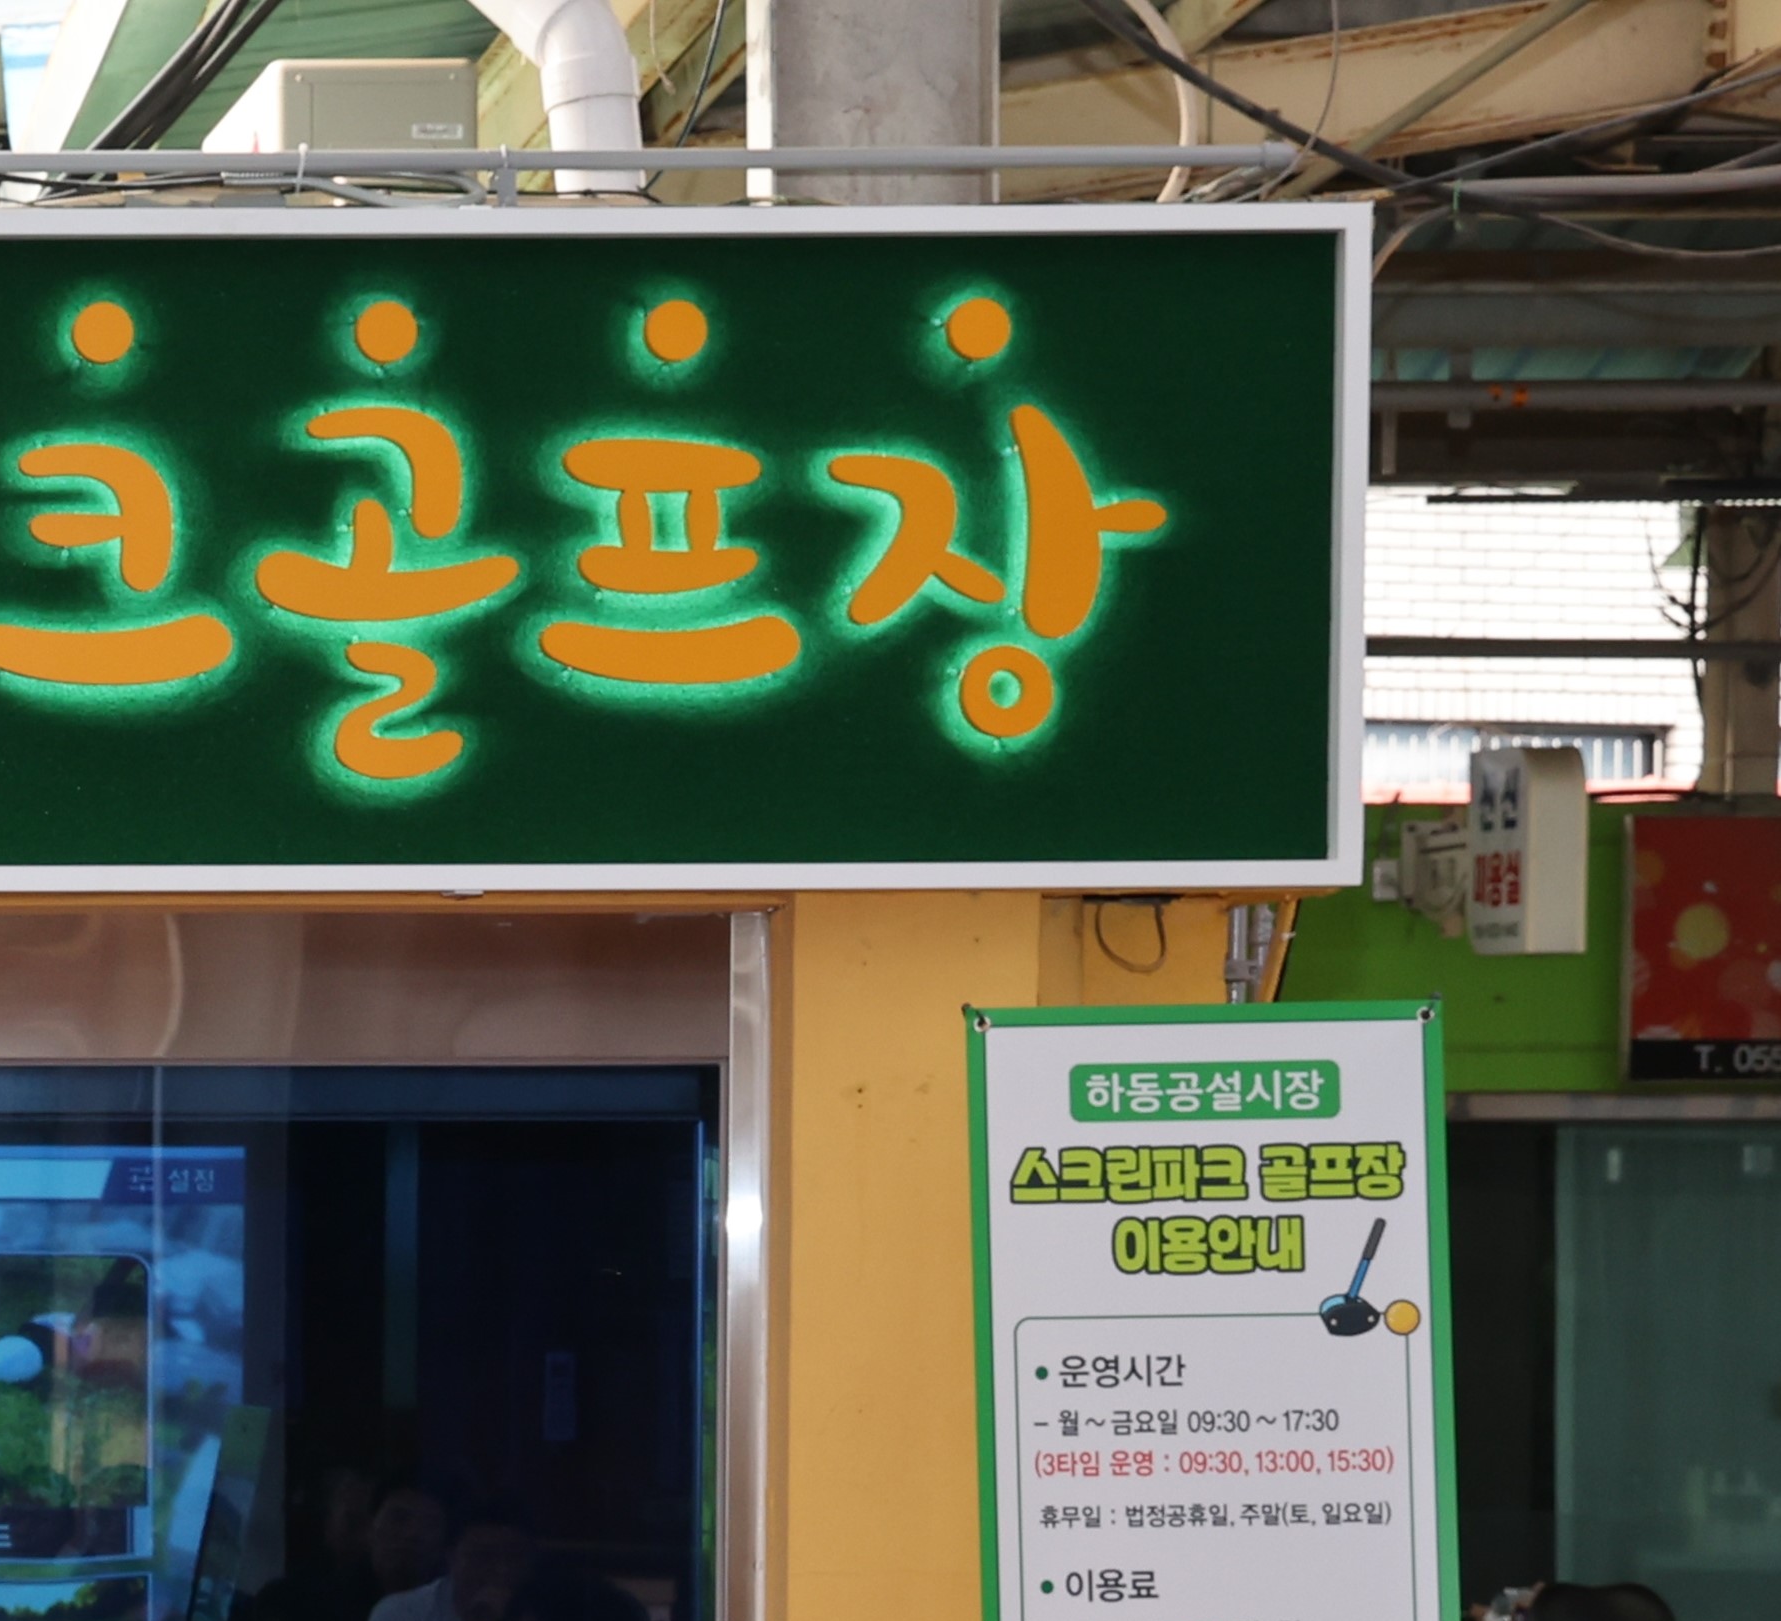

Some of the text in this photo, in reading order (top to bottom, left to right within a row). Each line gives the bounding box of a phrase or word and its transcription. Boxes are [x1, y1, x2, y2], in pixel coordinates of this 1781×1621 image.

[1086, 1069, 1326, 1114] 하동공설시장
[1010, 1142, 1407, 1204] 스크린파크 골프장
[1113, 1215, 1306, 1275] 이용안내
[1058, 1354, 1186, 1389] 운영시간
[1111, 1409, 1179, 1436] 금요일
[1034, 1450, 1101, 1478] (3타임
[1109, 1450, 1155, 1477] 운영
[1179, 1450, 1250, 1477] 09:30,
[1255, 1449, 1321, 1475] 13:00,
[1327, 1446, 1395, 1474] 15:30)
[1039, 1504, 1102, 1529] 휴무일
[1125, 1503, 1235, 1529] 법정공휴일,
[1240, 1502, 1316, 1527] 주말(토,
[1322, 1501, 1393, 1526] 일요일)
[1065, 1568, 1159, 1603] 이용료
